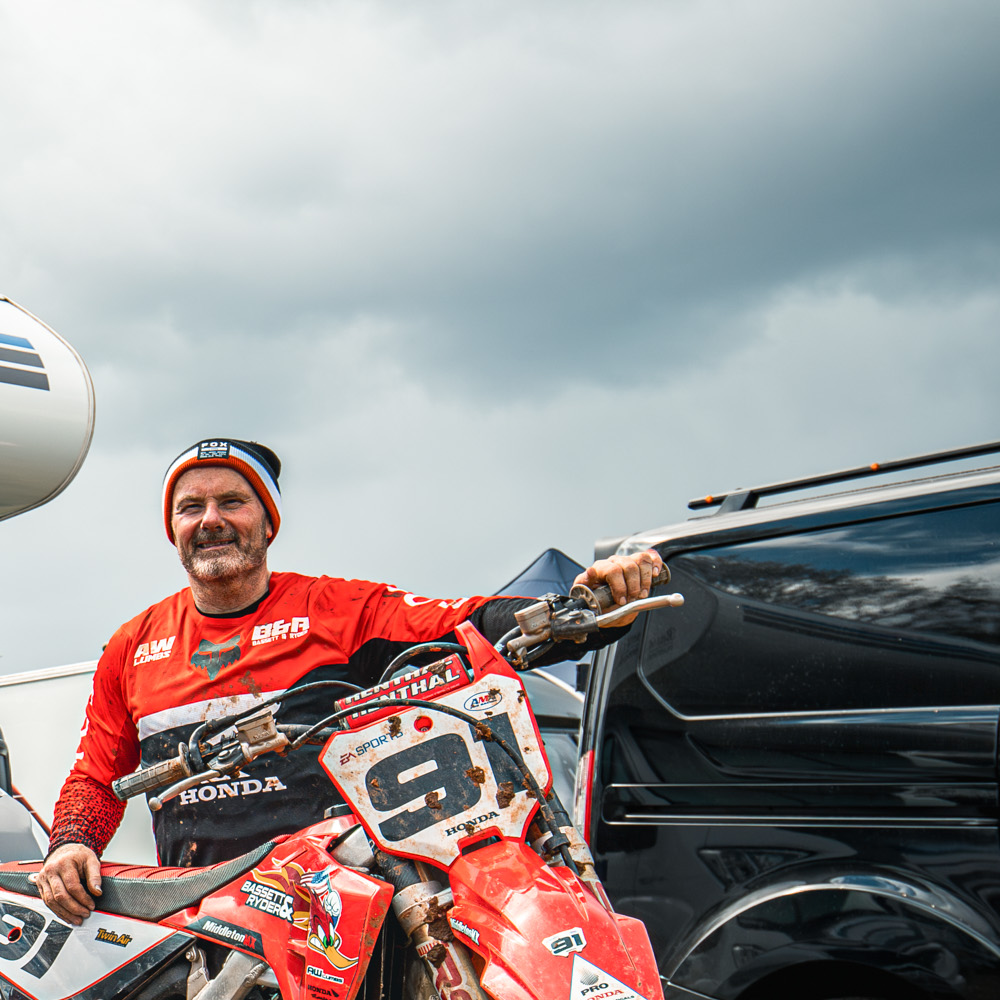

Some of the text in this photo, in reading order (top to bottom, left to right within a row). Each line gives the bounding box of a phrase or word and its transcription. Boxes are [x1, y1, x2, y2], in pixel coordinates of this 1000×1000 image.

[134, 635, 176, 659] AW
[252, 636, 281, 646] BASSETT
[133, 651, 171, 667] LUMBS
[365, 712, 532, 842] 91
[179, 776, 288, 806] HONDA
[444, 810, 501, 837] HONDA
[241, 879, 294, 922] BASSETT &
[246, 894, 281, 916] RYDER
[97, 927, 118, 943] Twin
[116, 933, 133, 946] Air
[550, 933, 584, 955] 91
[307, 984, 333, 997] HONDA
[580, 982, 609, 997] PRO
